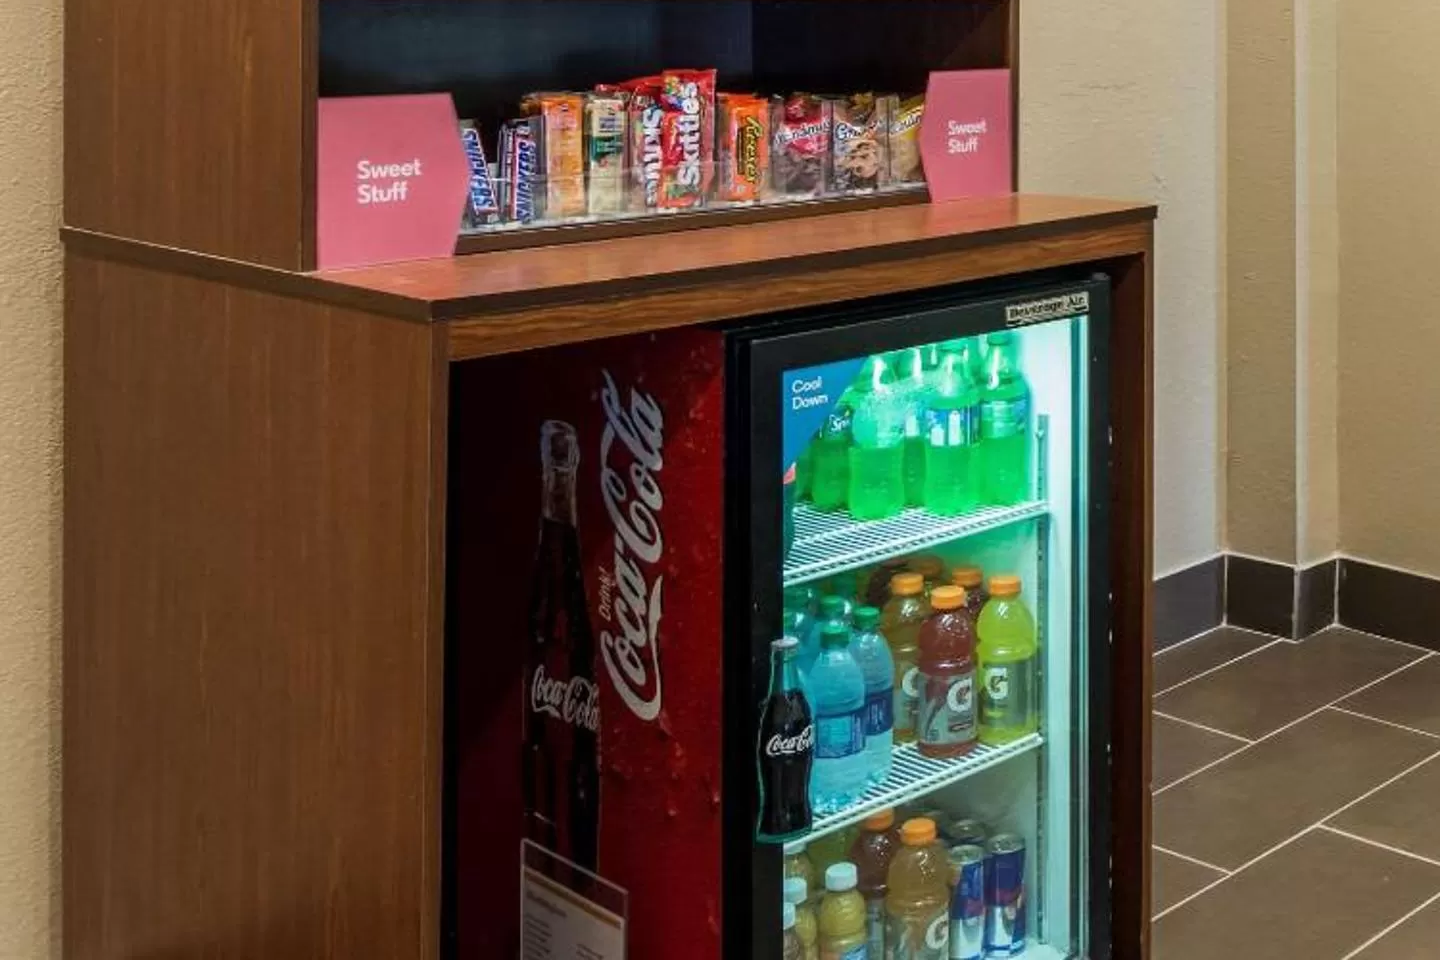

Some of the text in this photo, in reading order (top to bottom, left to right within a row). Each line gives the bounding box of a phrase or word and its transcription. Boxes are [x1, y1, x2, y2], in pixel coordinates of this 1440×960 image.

[677, 82, 700, 186] Skittles
[948, 120, 987, 135] Sweet
[948, 137, 978, 153] Stuff
[357, 157, 422, 179] Sweet
[357, 181, 408, 204] Stuff
[792, 376, 822, 393] Cool
[792, 394, 828, 410] Down
